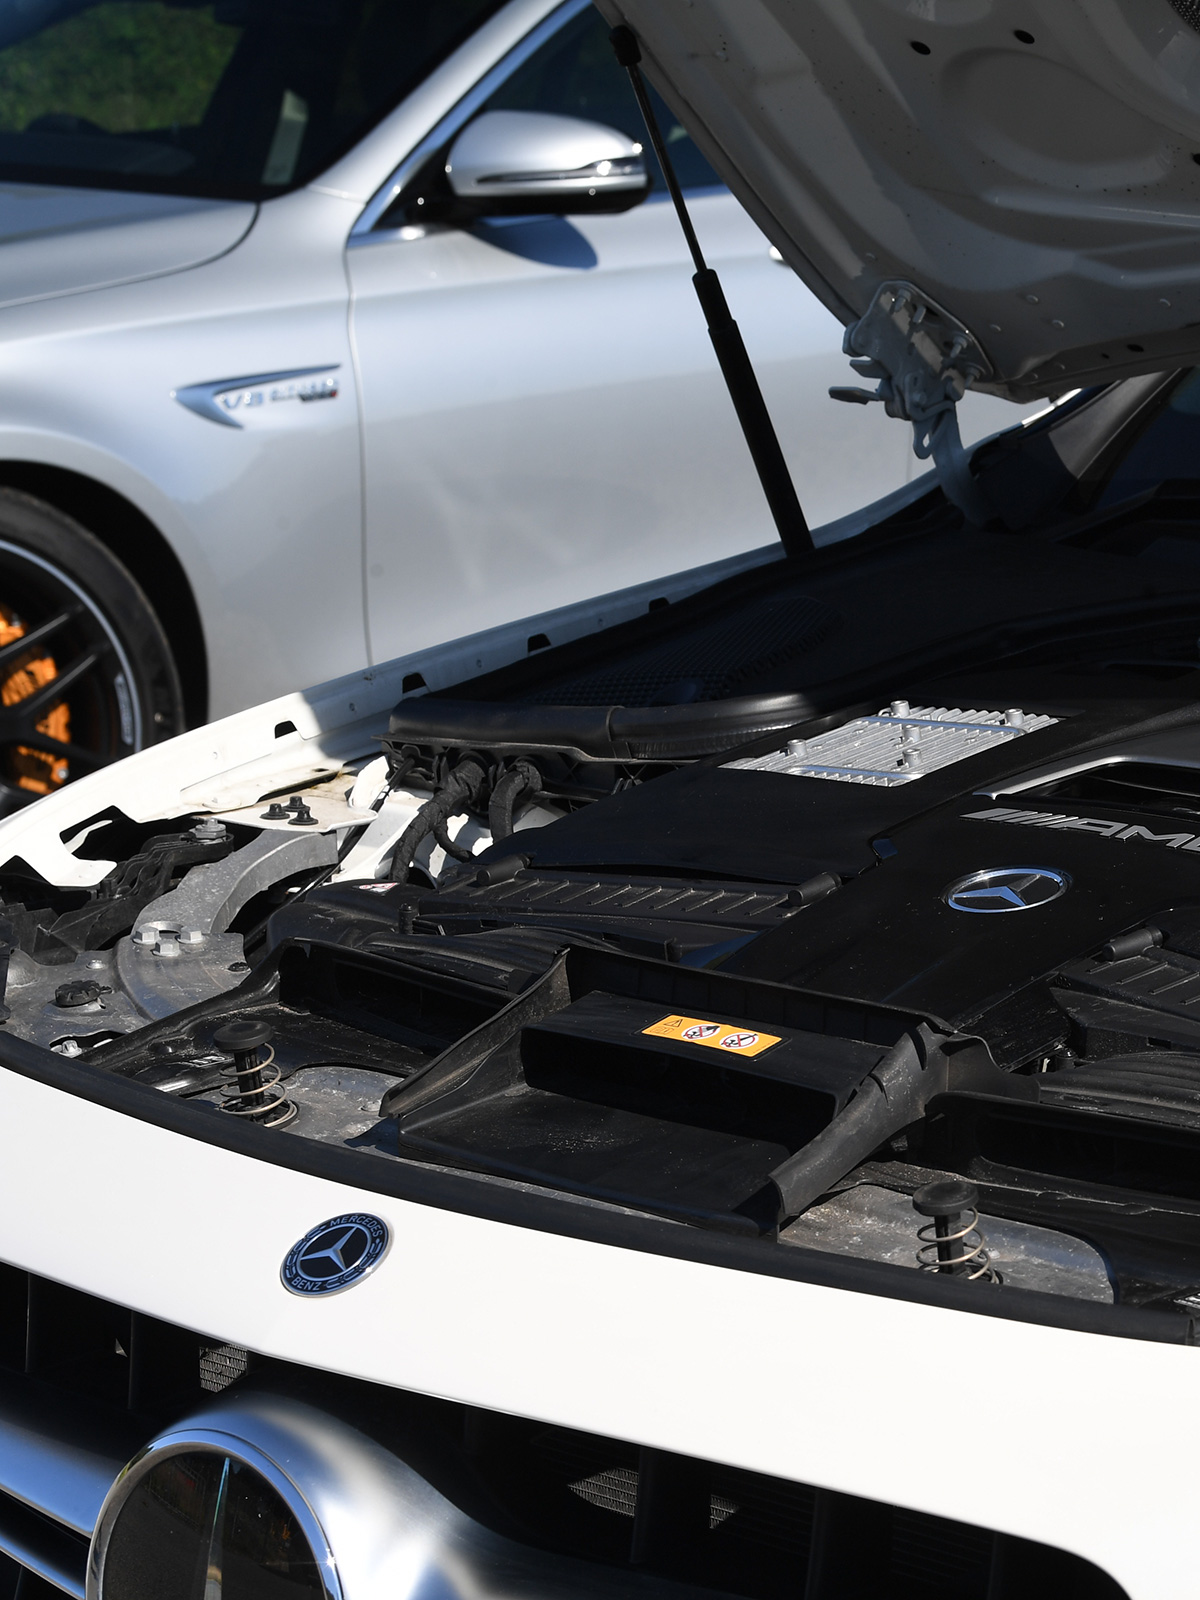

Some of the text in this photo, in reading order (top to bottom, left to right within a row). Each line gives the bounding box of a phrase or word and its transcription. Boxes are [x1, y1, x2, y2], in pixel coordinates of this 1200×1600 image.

[219, 391, 263, 409] V8
[329, 1215, 384, 1238] MERCEDES
[291, 1277, 323, 1291] BENZ
